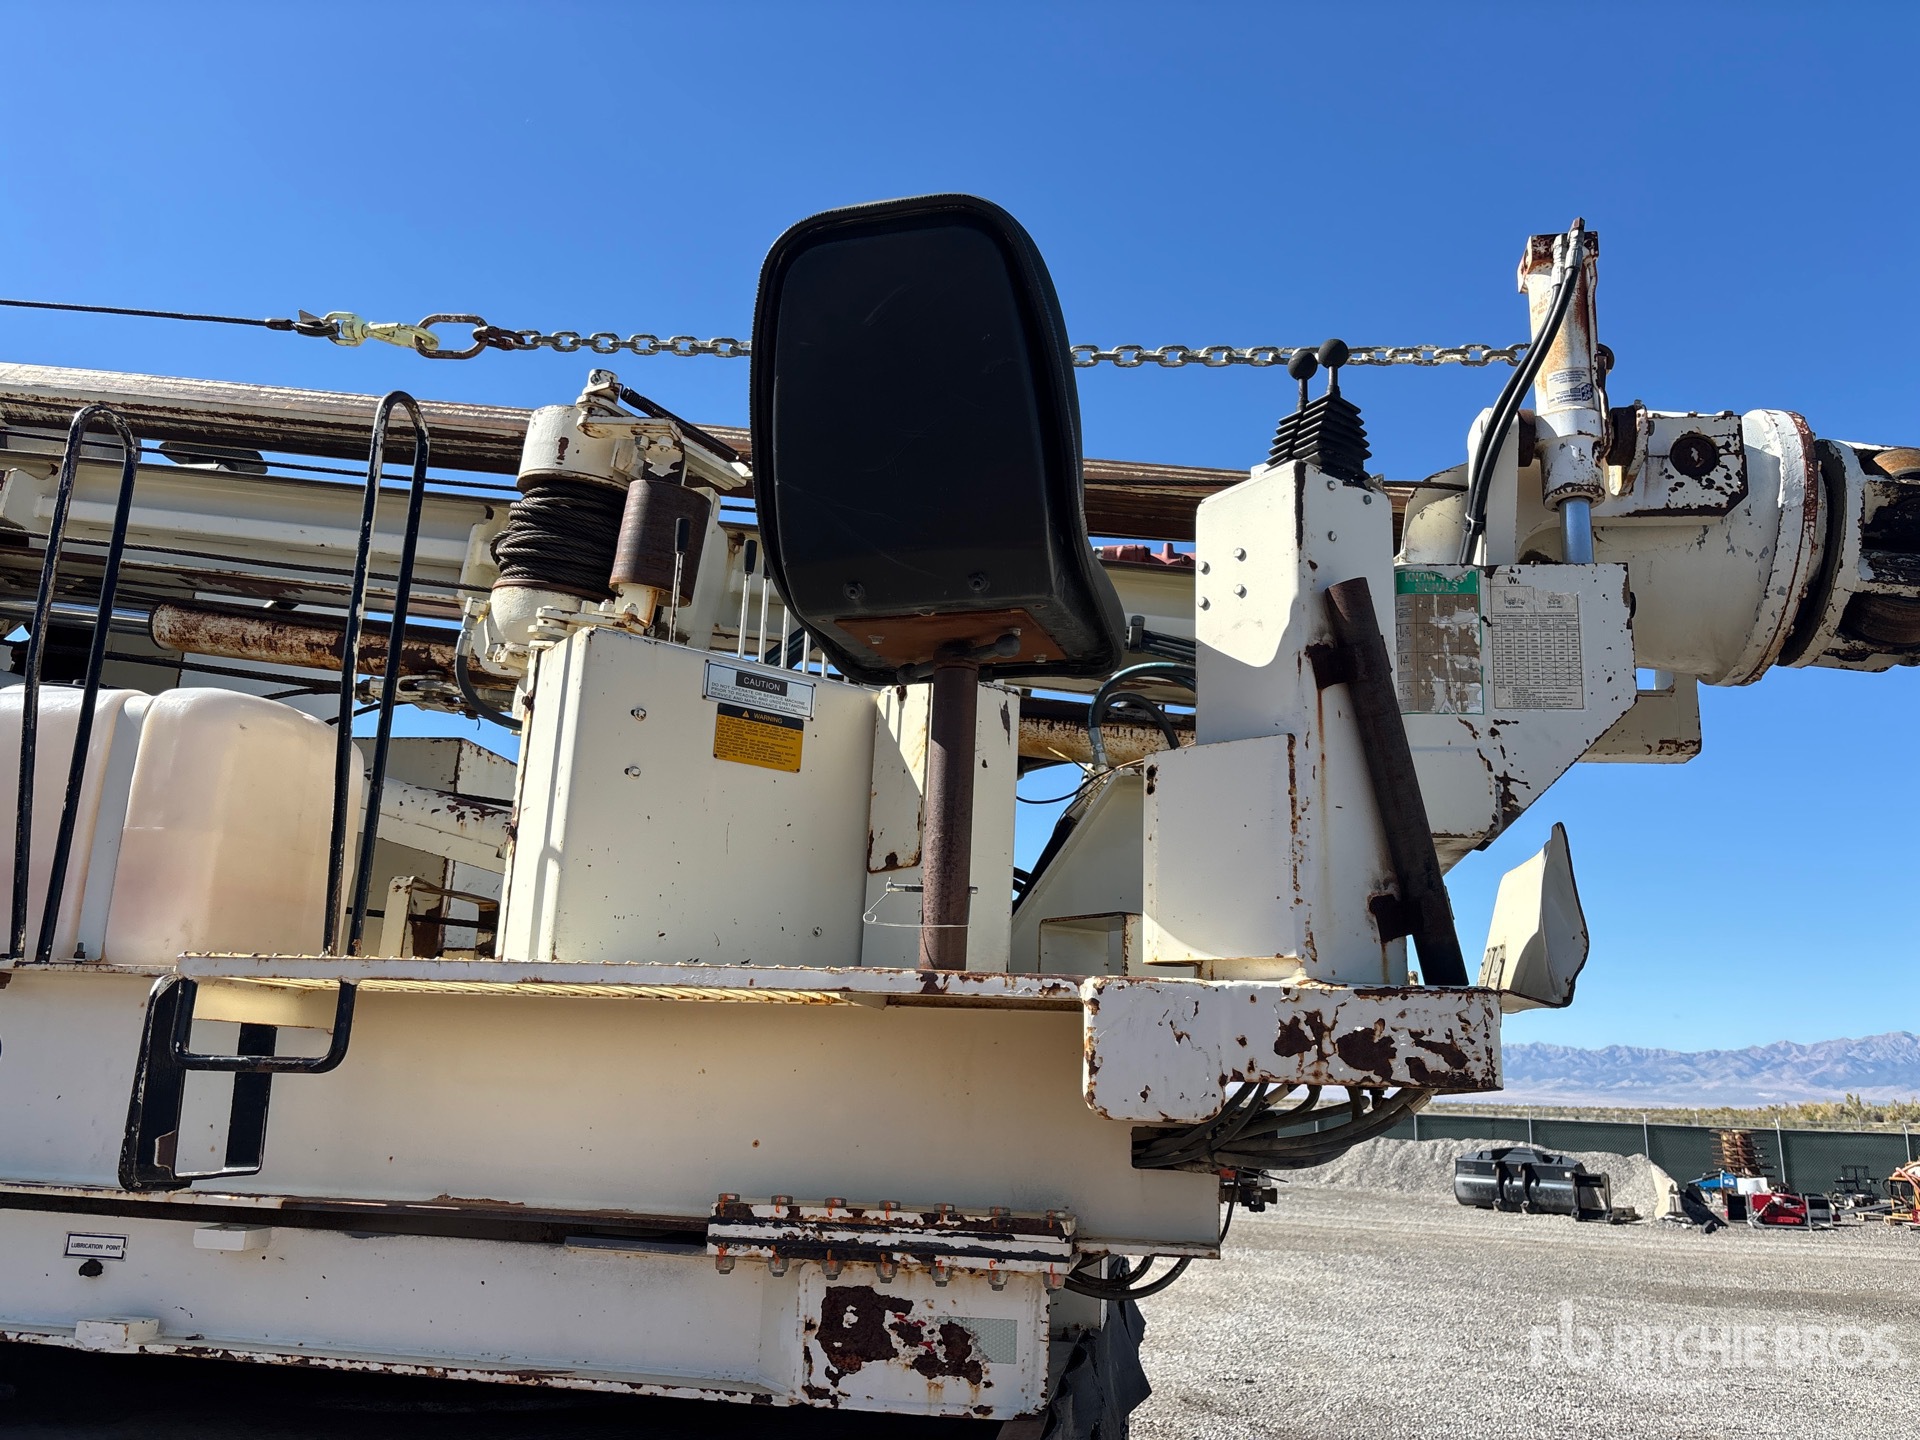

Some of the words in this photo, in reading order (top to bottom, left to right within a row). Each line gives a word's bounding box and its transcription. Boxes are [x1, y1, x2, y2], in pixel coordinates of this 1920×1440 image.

[1405, 572, 1436, 582] KNOW
[1415, 582, 1459, 592] SIGNALS
[743, 677, 780, 691] CAUTION
[731, 686, 753, 695] OPERATE
[764, 693, 783, 701] SERVICE
[745, 698, 778, 708] MAINTENANCE
[754, 713, 783, 724] WARNING
[71, 1242, 103, 1250] LUBRICATION
